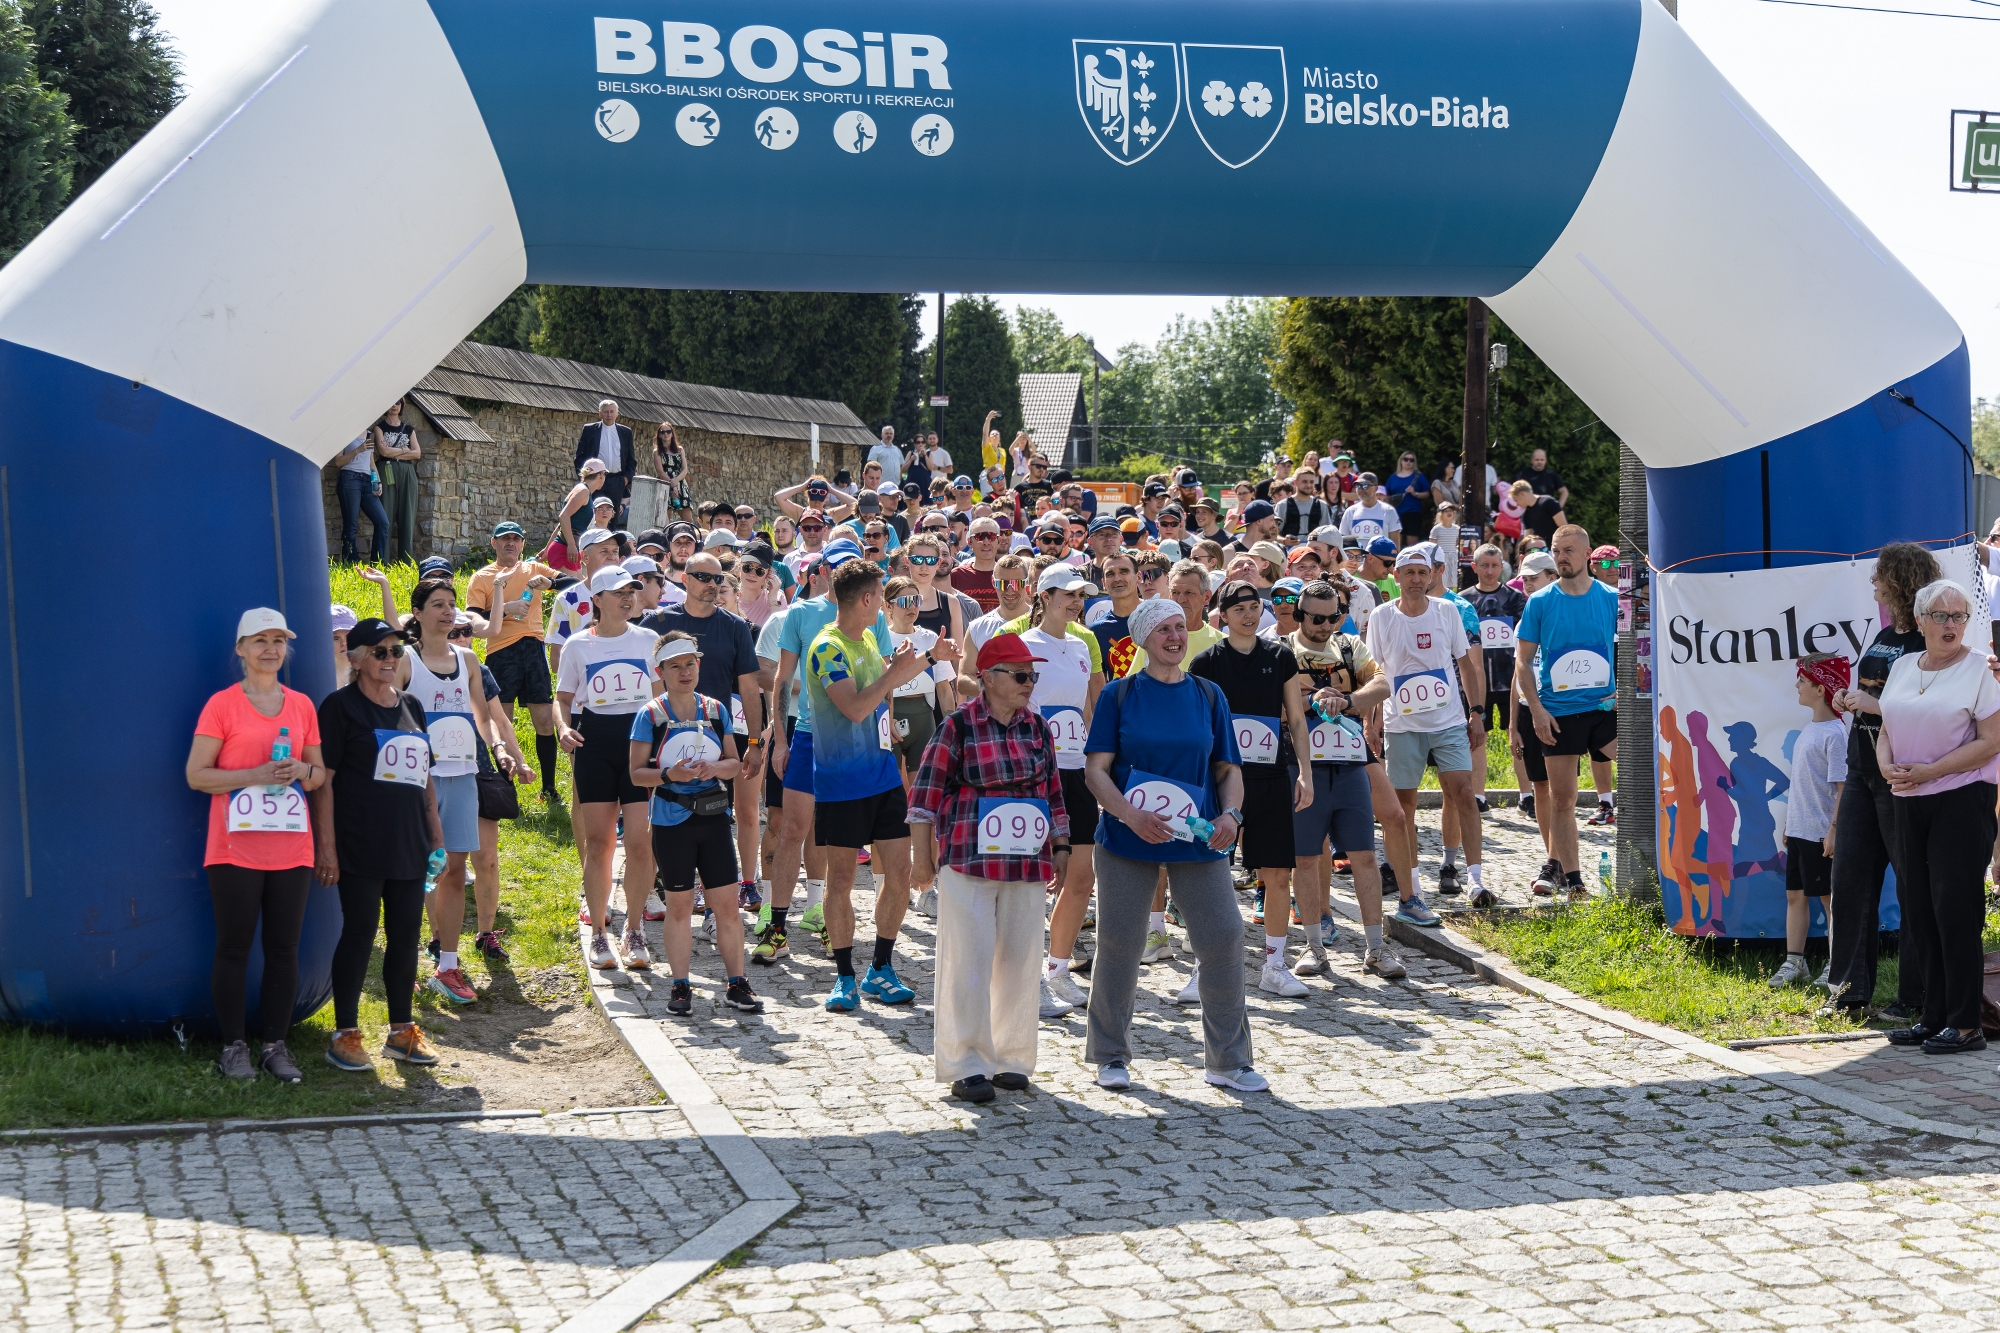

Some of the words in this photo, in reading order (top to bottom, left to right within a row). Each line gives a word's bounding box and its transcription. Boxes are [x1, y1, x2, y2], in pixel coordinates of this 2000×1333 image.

[594, 17, 953, 90] BBOSiR
[1303, 67, 1379, 89] Miasto
[598, 81, 722, 98] BIELSKO-BIALSKI
[726, 86, 799, 101] OŚRODEK
[803, 91, 862, 105] SPORTU
[867, 94, 870, 104] I
[875, 95, 954, 108] REKREACJI
[1305, 93, 1510, 129] Bielsko-Biała
[1978, 143, 2000, 167] u
[1354, 525, 1380, 535] 088
[1480, 626, 1510, 640] 85
[1669, 605, 1875, 668] Stanley
[1565, 660, 1591, 675] 123
[592, 671, 644, 694] 017
[1400, 681, 1446, 704] 006
[385, 744, 429, 773] 053
[236, 793, 301, 816] 052
[1129, 788, 1193, 820] 024
[985, 815, 1046, 840] 099
